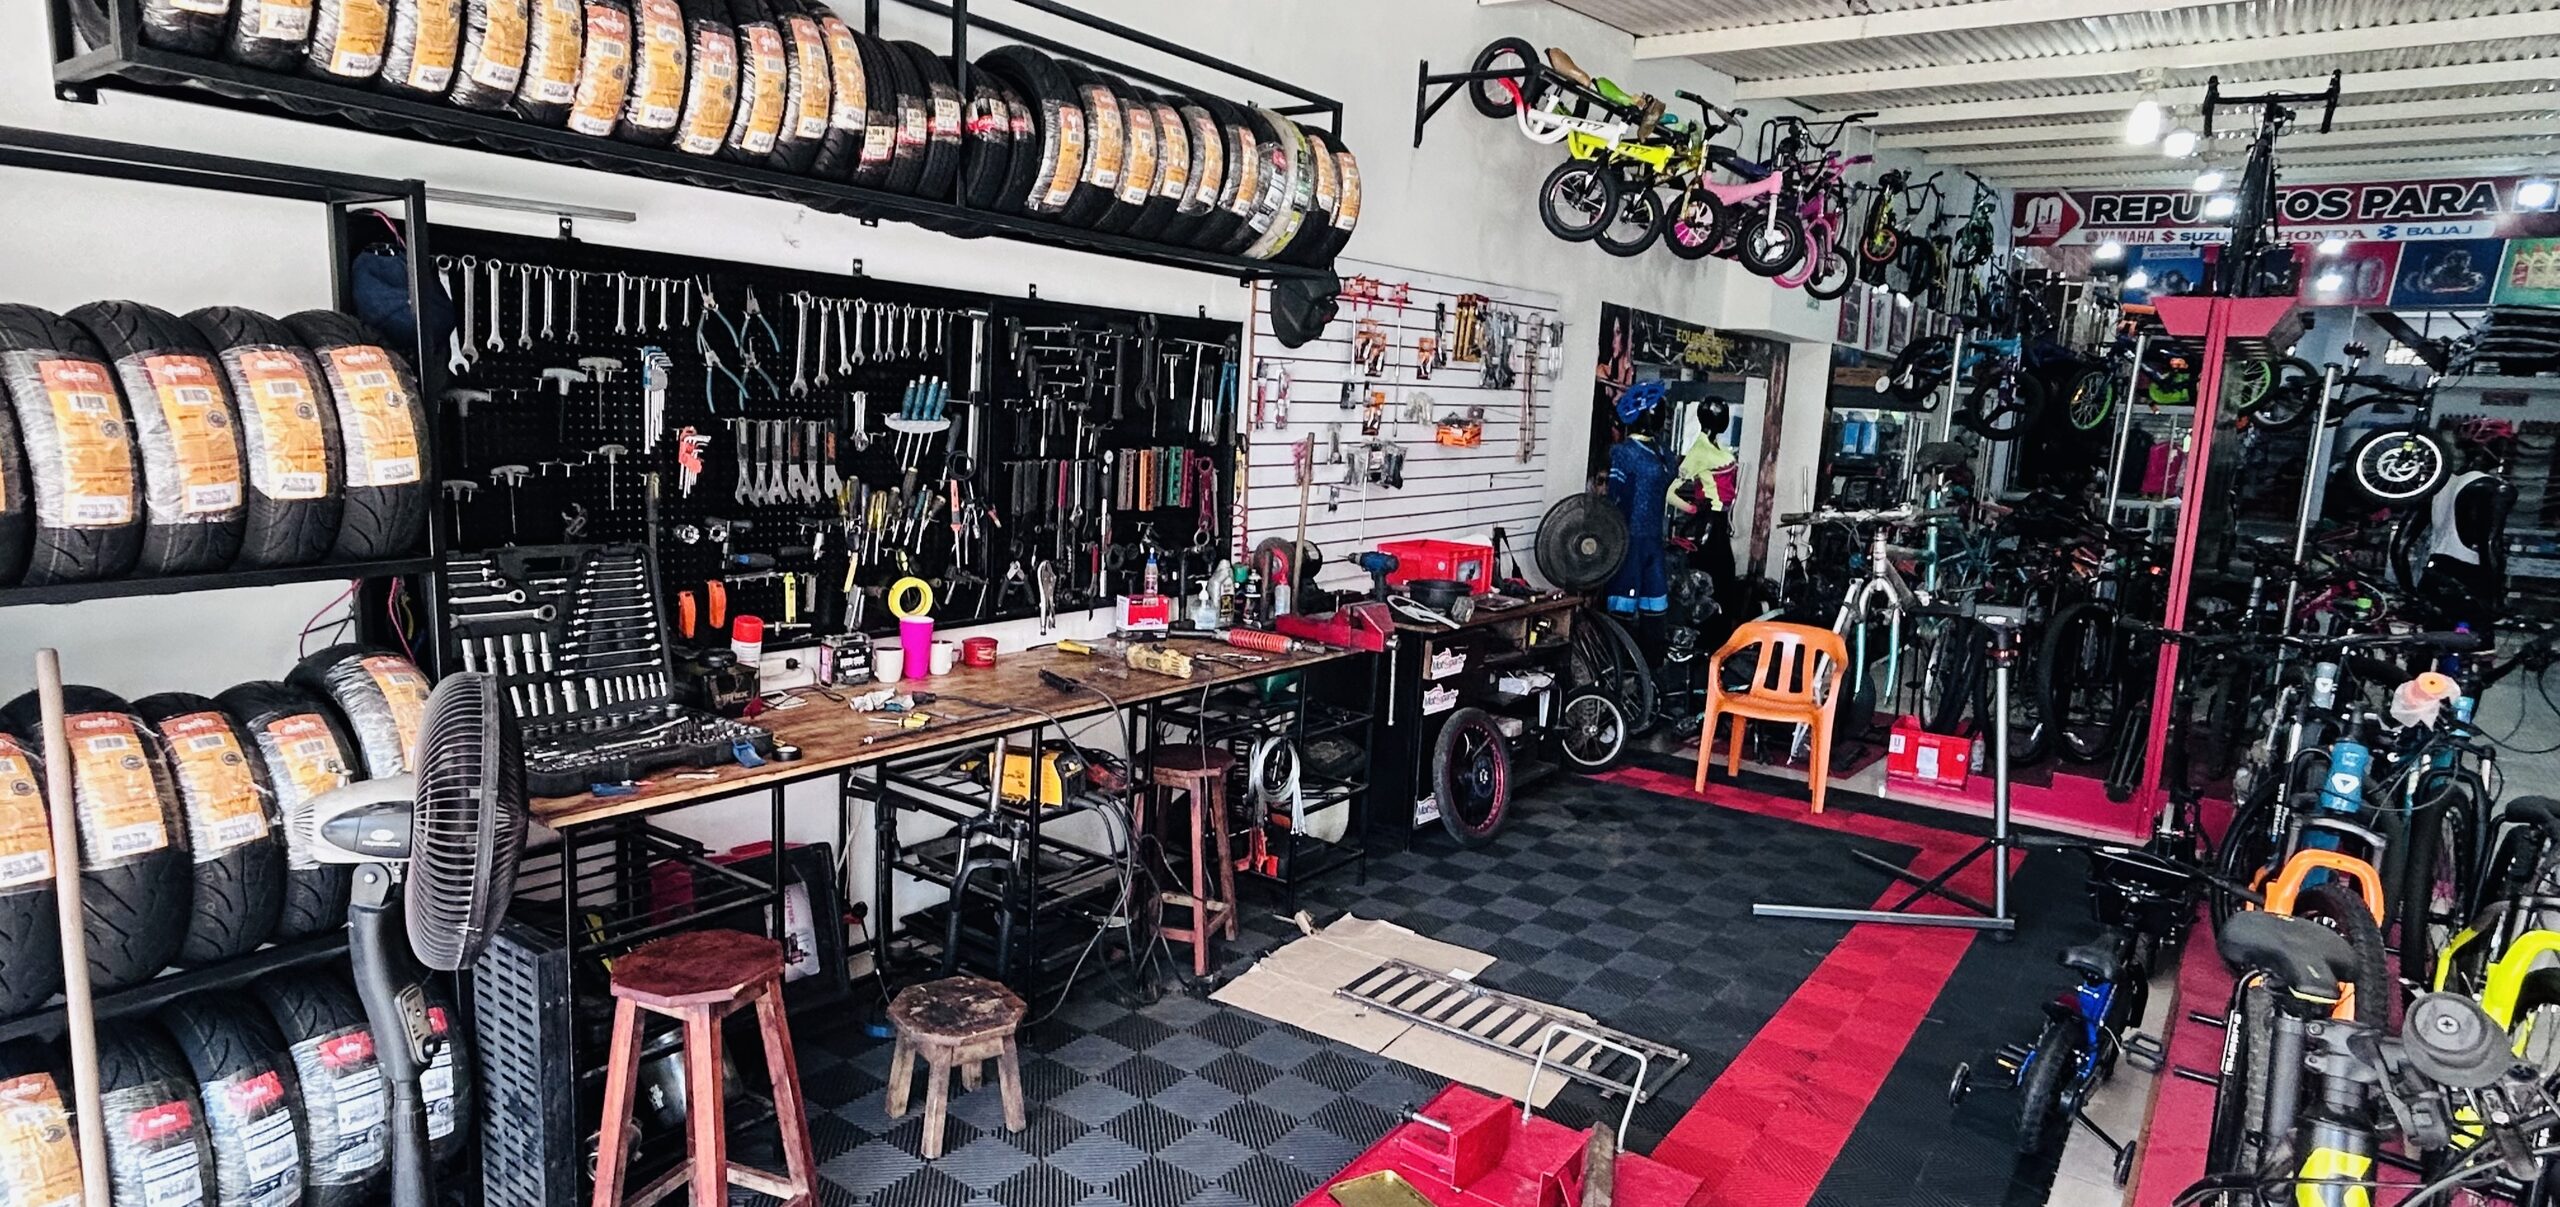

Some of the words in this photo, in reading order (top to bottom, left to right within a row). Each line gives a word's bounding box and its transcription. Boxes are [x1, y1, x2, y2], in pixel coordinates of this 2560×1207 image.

[2090, 188, 2353, 225] REPUOS
[2358, 181, 2501, 220] PARA
[2100, 230, 2155, 244] YAMAHA
[2179, 231, 2232, 243] SUZU
[2277, 228, 2366, 242] HONDA
[2406, 225, 2473, 236] BAJAJ
